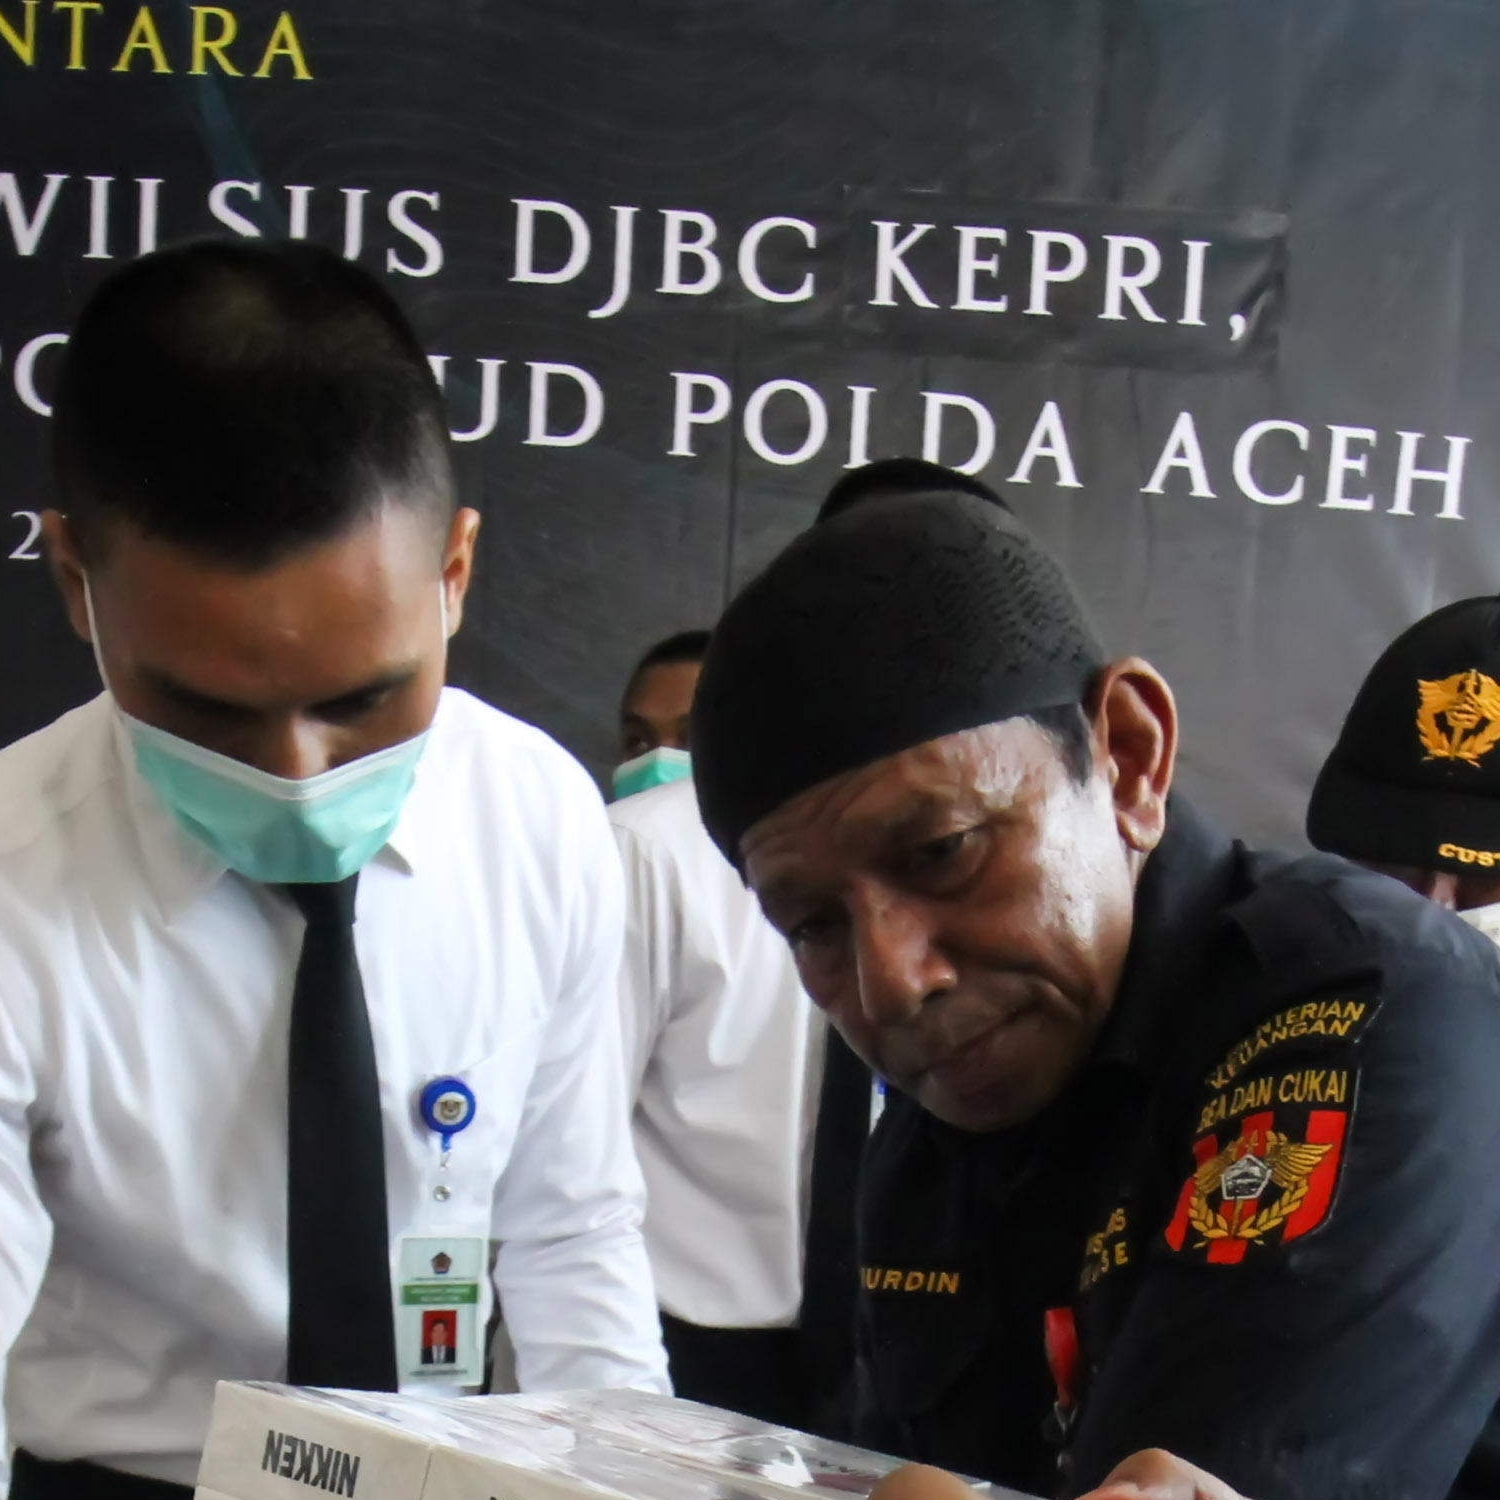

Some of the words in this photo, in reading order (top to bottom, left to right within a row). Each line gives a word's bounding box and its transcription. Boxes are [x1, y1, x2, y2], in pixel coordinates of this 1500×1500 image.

[508, 198, 817, 320] DJBC
[869, 220, 1248, 342] KEPRI,
[1141, 411, 1472, 519] ACEH
[1229, 1075, 1274, 1116] DAN
[1278, 1069, 1348, 1103] CUKAI
[859, 1266, 960, 1294] URDIN
[262, 1430, 360, 1499] NIKKEN
